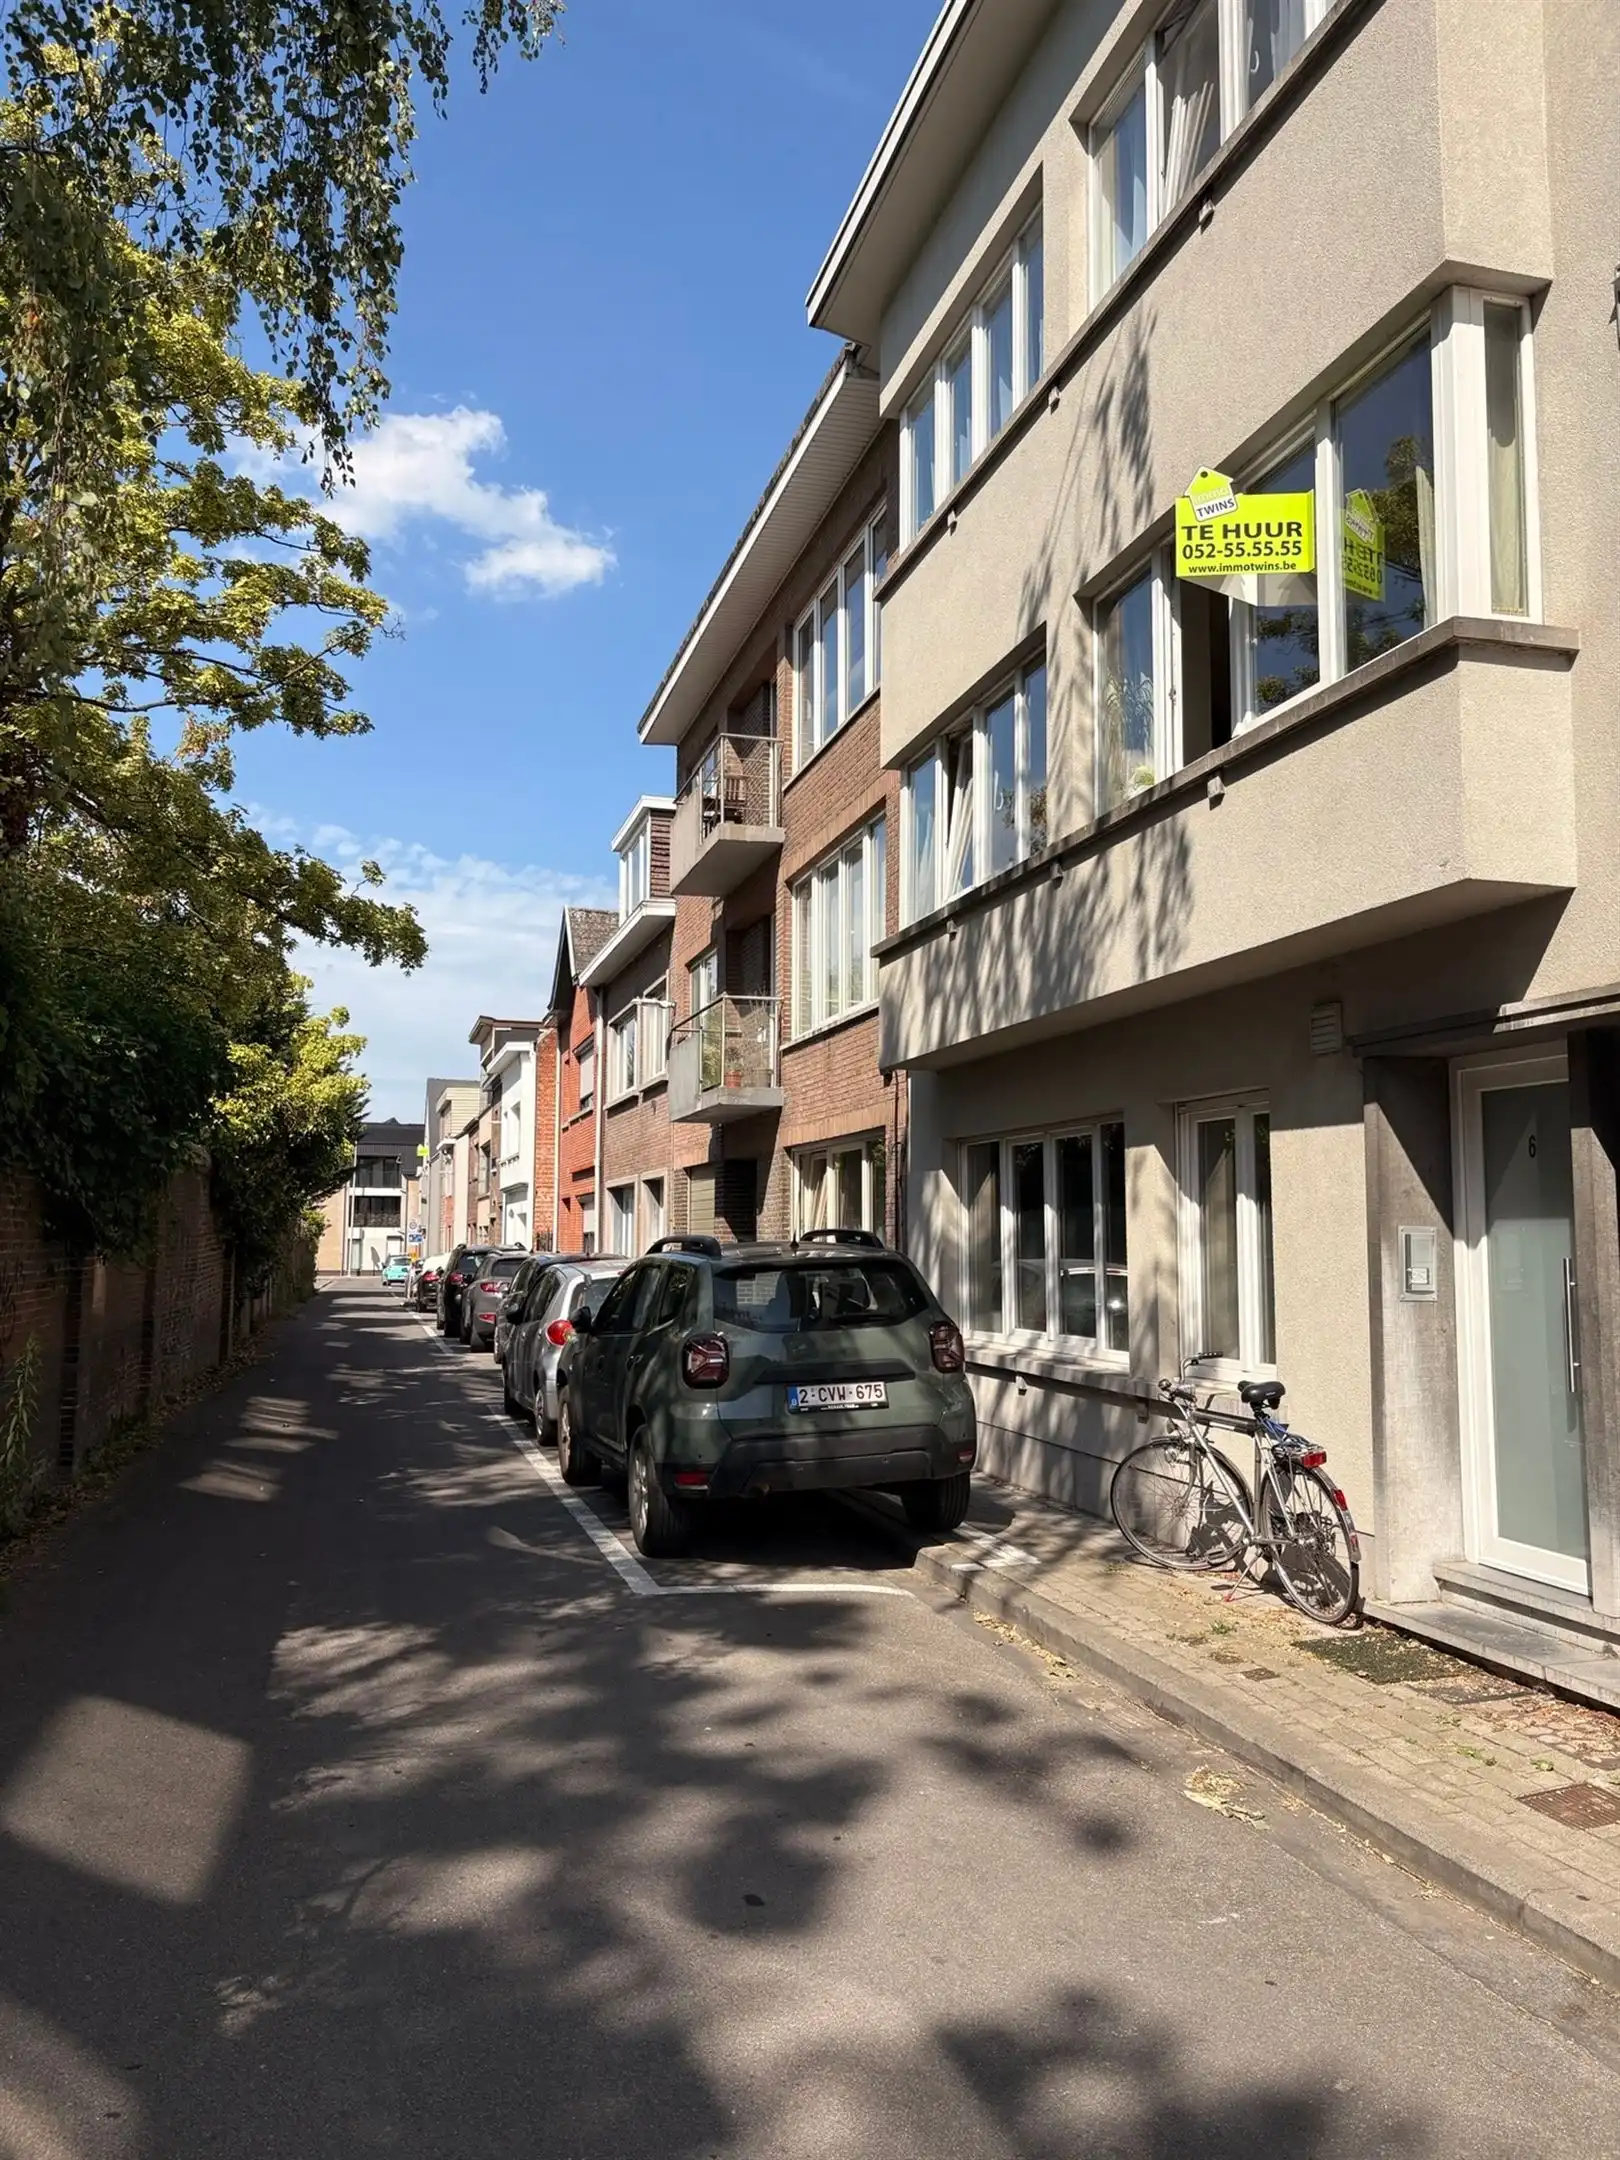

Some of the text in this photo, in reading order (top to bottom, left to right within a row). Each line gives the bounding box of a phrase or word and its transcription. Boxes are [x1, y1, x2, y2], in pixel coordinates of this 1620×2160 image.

[1196, 498, 1235, 517] TWINS
[1181, 521, 1303, 541] TE HUUR
[1182, 540, 1302, 560] 052-55.55.55
[1188, 561, 1297, 574] www.immotwins.be
[1528, 1134, 1537, 1158] 6
